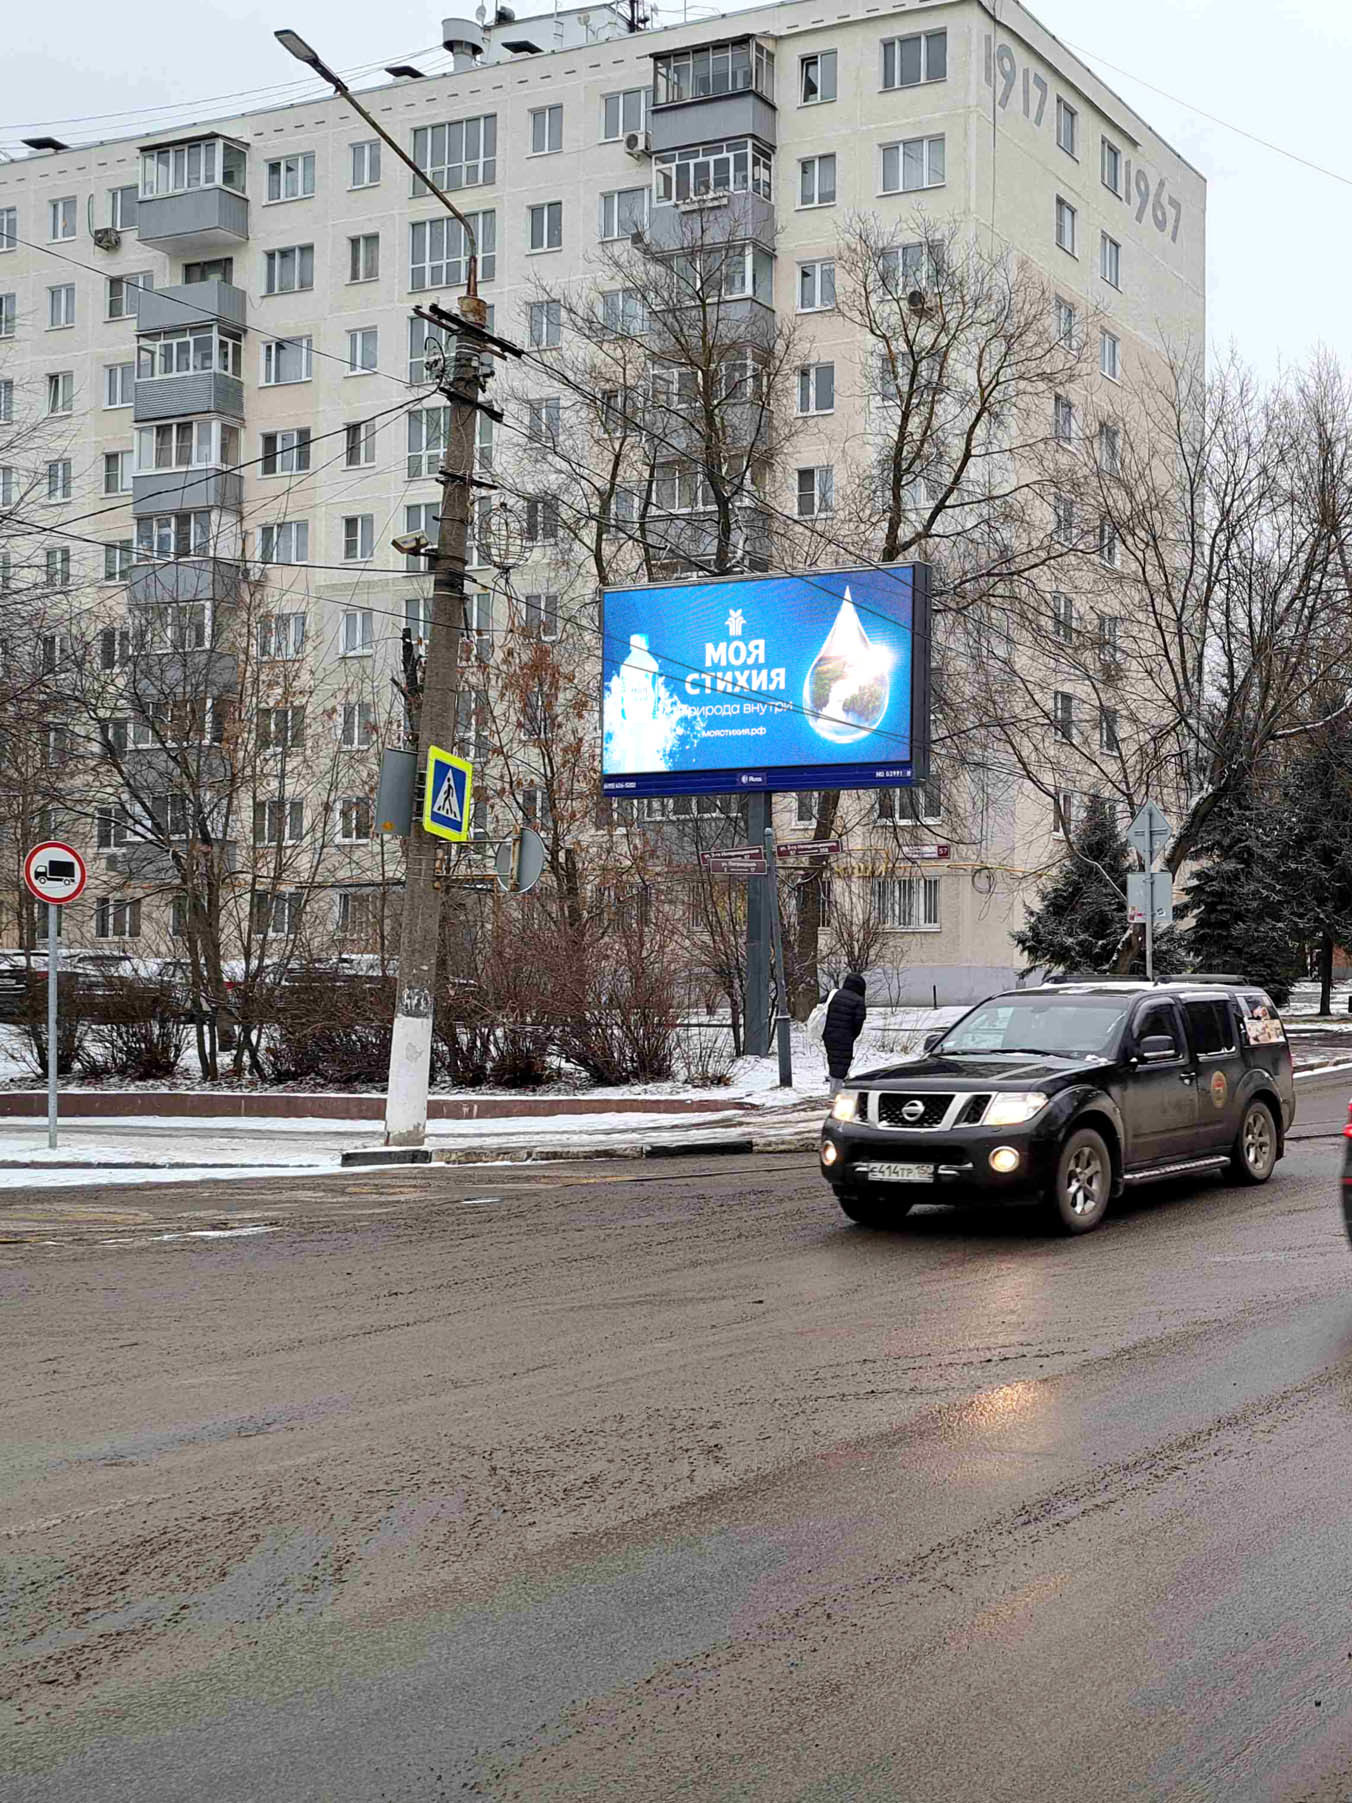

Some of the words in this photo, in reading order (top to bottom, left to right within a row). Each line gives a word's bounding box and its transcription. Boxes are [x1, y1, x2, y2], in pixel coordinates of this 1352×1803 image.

[984, 34, 1048, 127] 1917
[1124, 159, 1182, 244] 1967
[705, 639, 765, 667] МОЯ
[684, 667, 786, 695] СТИХИЯ
[682, 703, 742, 718] рирода
[743, 701, 793, 716] внутри
[939, 847, 948, 855] 57
